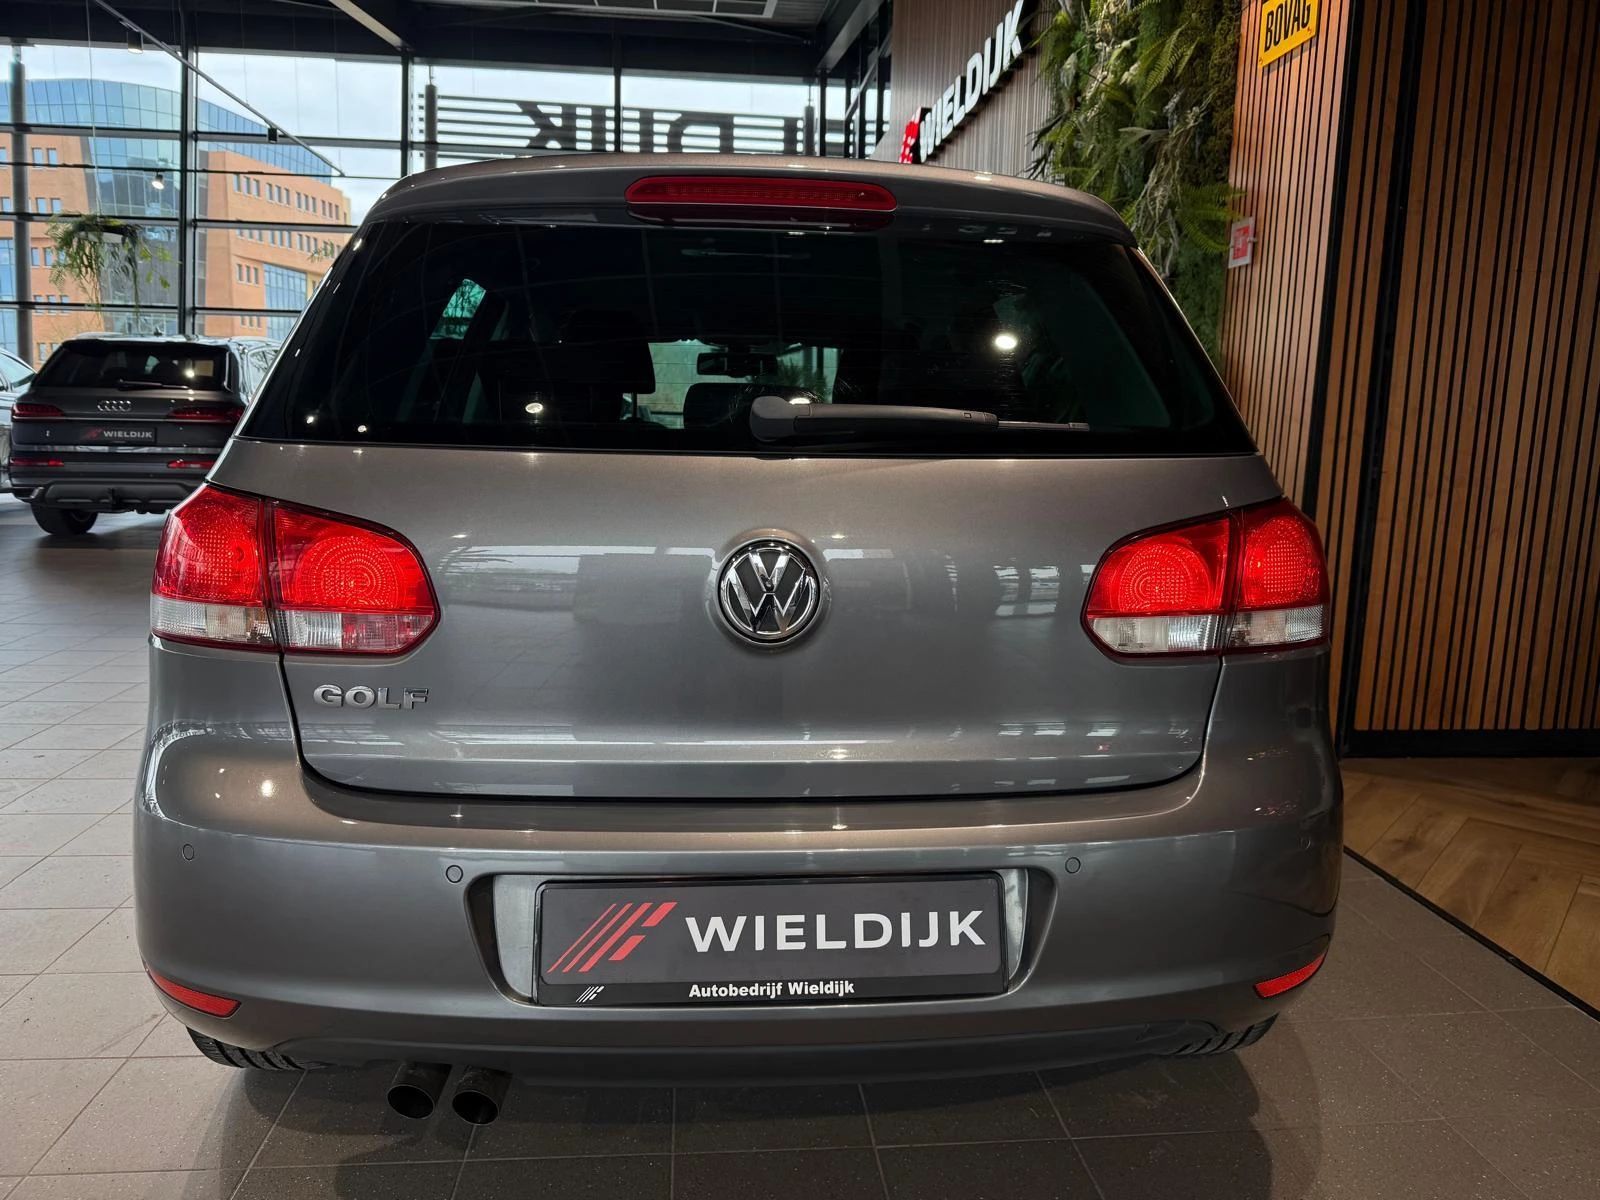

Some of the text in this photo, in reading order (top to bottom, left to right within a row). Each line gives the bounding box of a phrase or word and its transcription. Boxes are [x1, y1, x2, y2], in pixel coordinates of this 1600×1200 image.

[1264, 0, 1311, 53] BOVAG
[919, 0, 1024, 163] WIELDIJK
[103, 430, 153, 438] WIELDIJK
[313, 684, 429, 710] GOLF
[685, 910, 986, 953] WIELDIJK
[688, 980, 855, 999] Autobedrijf Wieldijk
